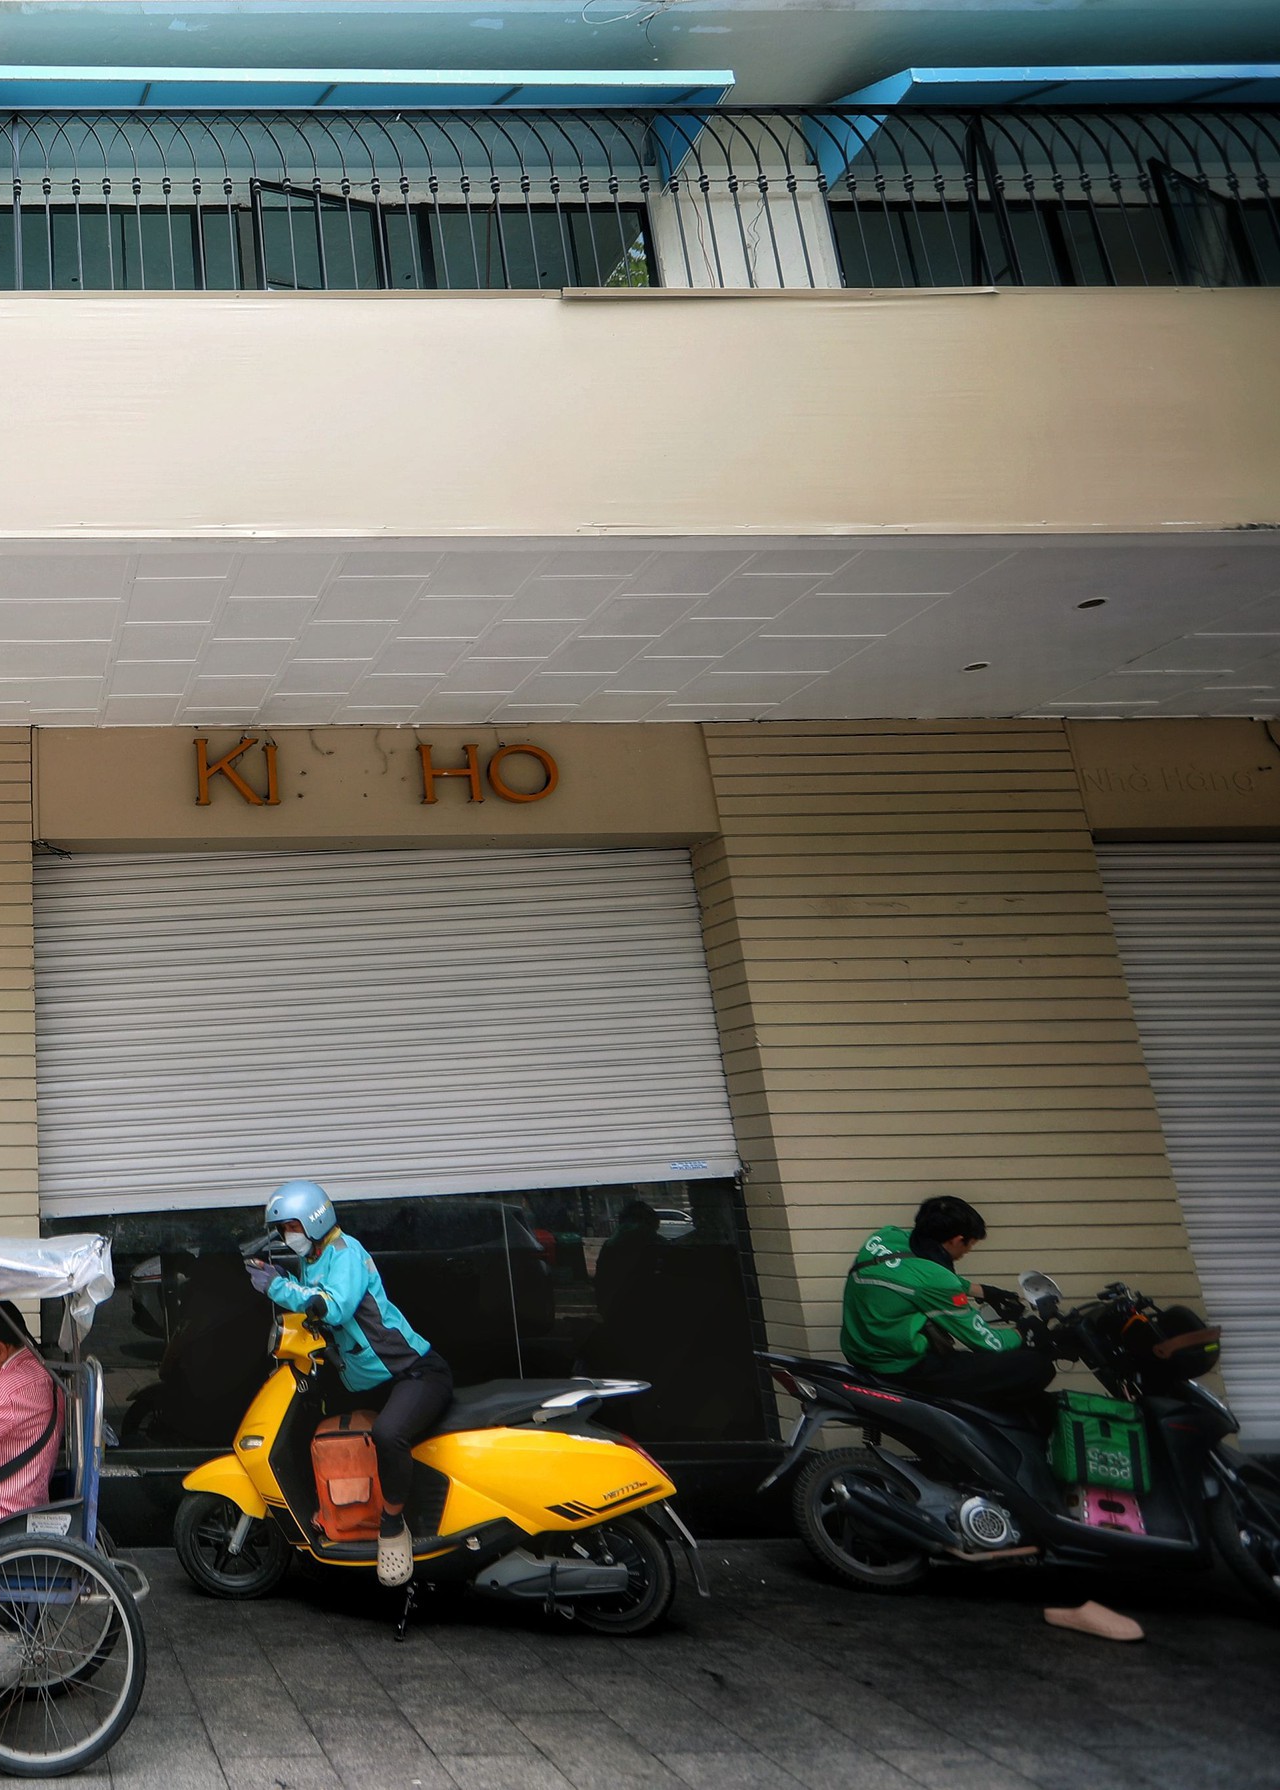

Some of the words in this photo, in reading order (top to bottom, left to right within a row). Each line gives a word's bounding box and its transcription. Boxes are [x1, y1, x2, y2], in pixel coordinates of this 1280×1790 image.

[192, 738, 282, 806] KI
[416, 743, 560, 804] HO
[1088, 1460, 1131, 1480] Food
